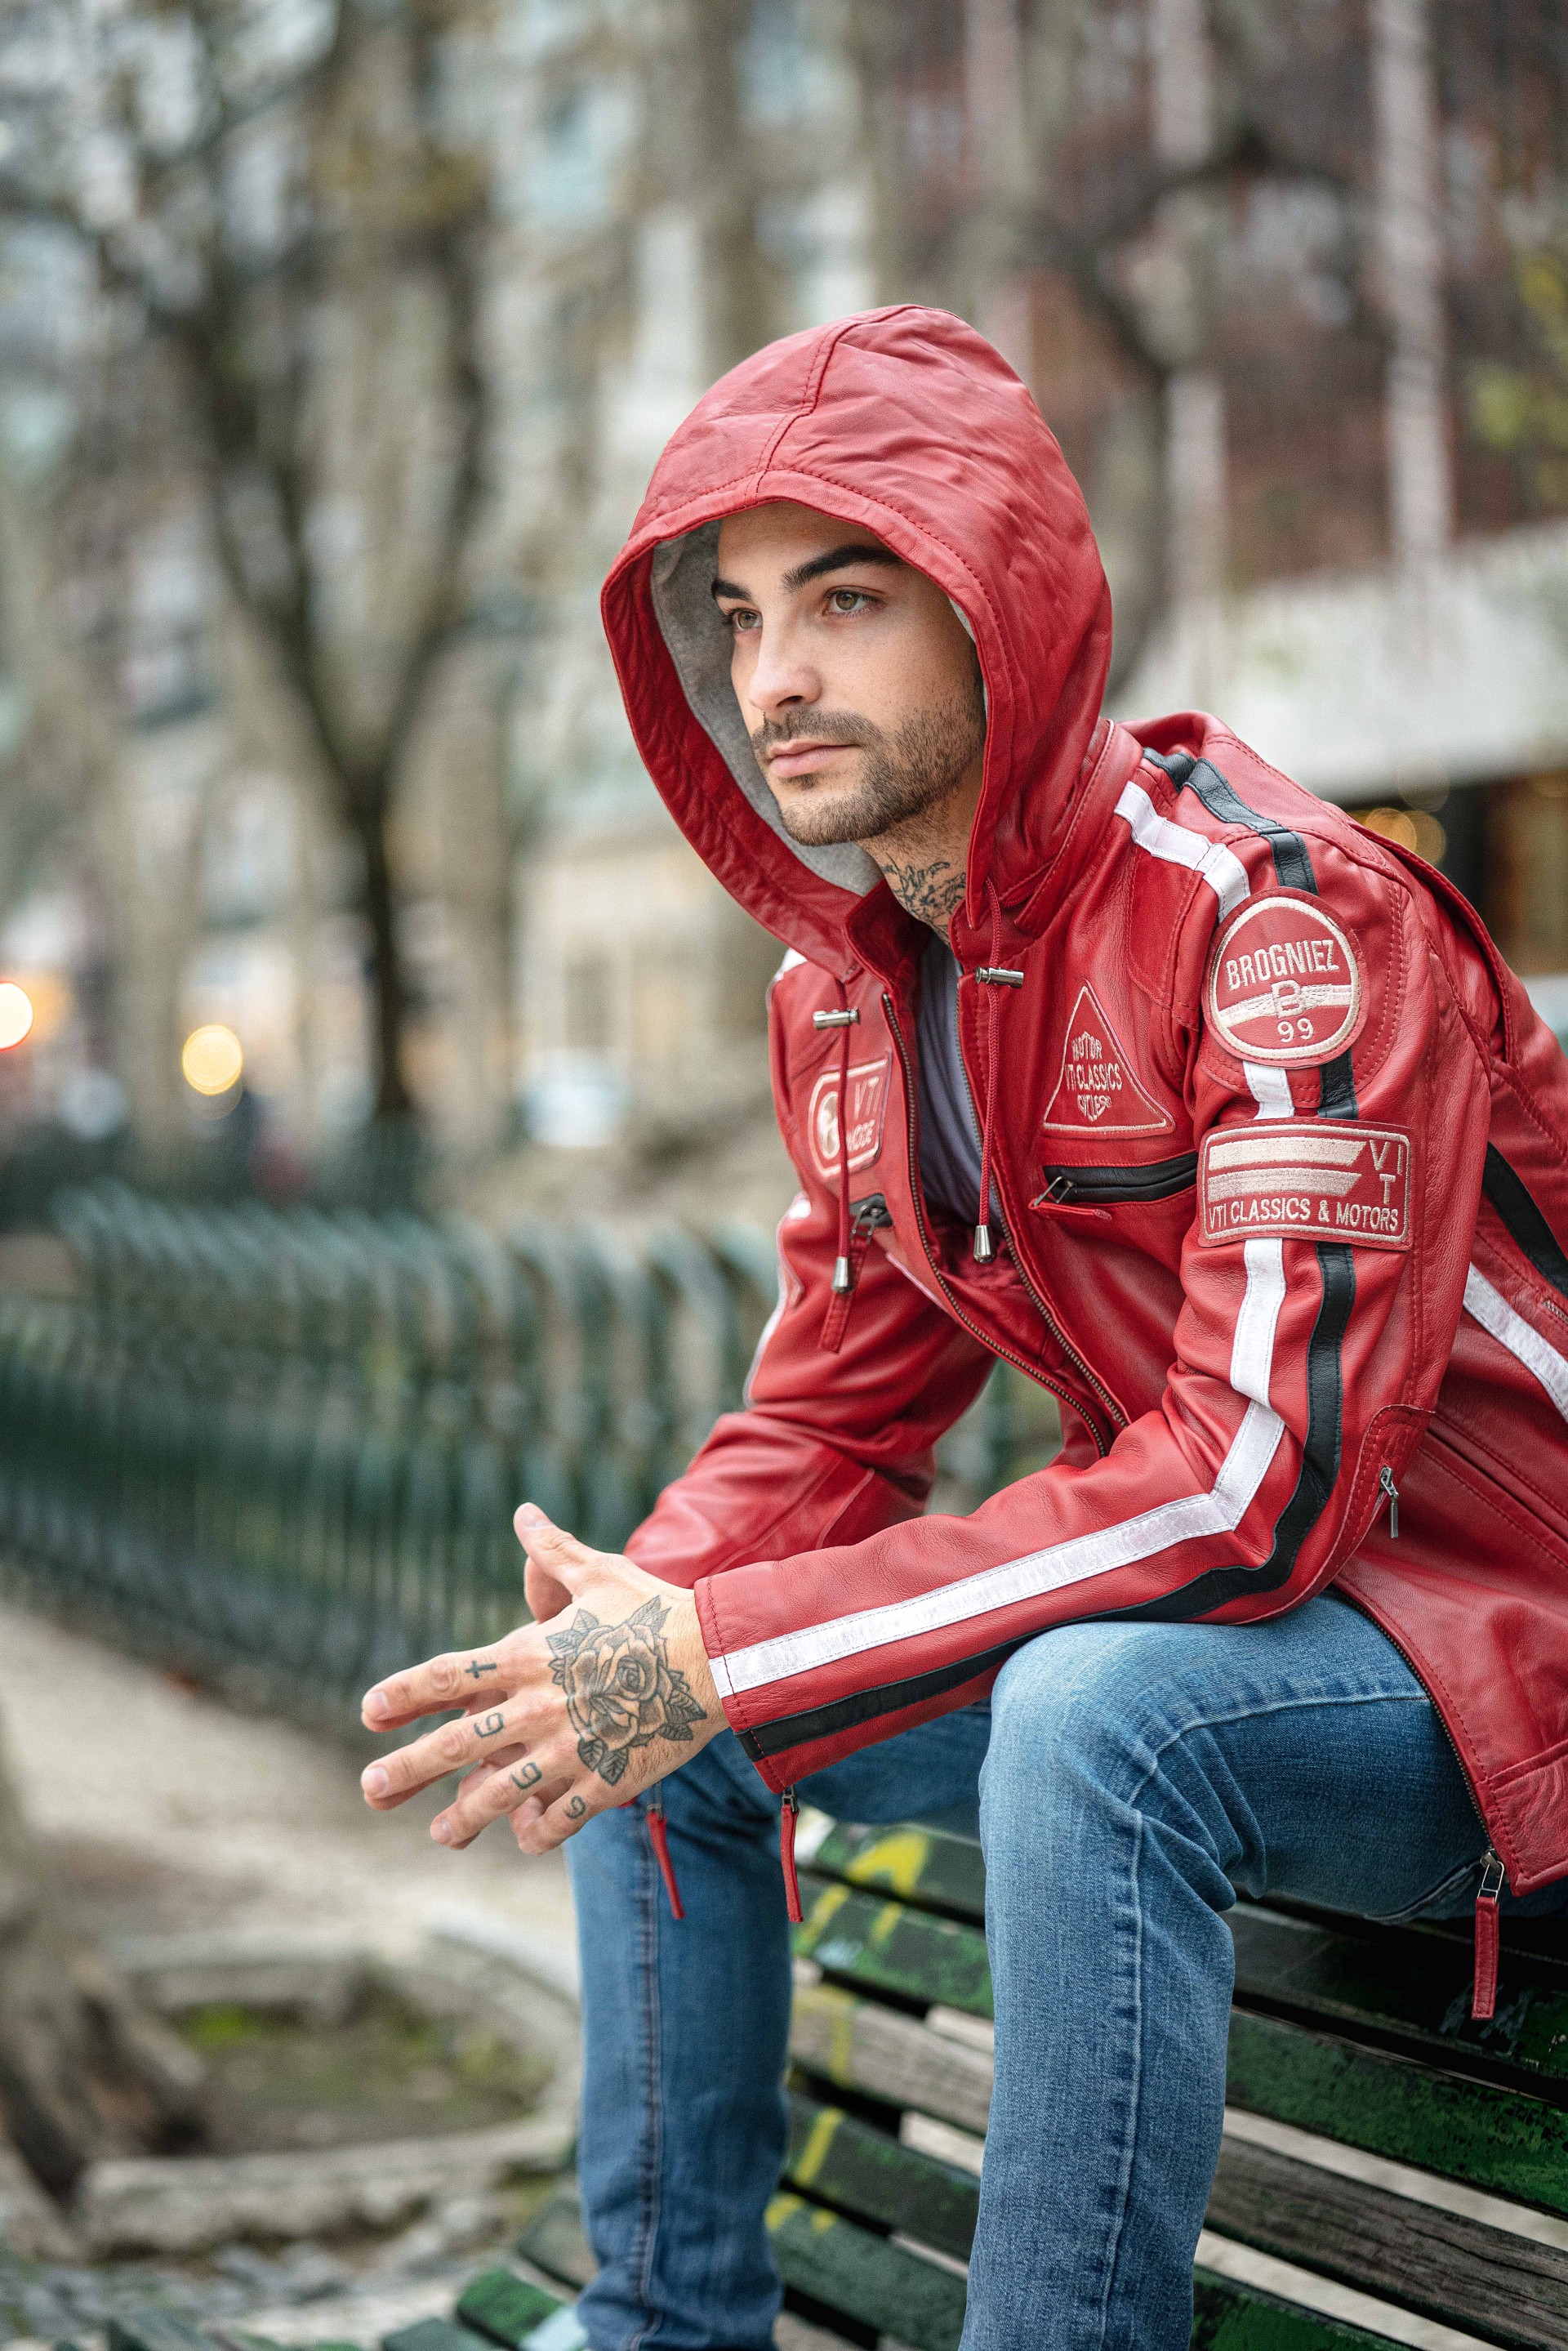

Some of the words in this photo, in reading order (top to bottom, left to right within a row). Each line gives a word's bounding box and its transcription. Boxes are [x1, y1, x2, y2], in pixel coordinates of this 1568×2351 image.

[1226, 939, 1339, 990] BROGNIEZ
[1272, 980, 1306, 1018] B
[1072, 1031, 1102, 1060] MOTOR
[1277, 1018, 1314, 1043] 99
[1076, 1063, 1122, 1091] CLASSICS
[1209, 1202, 1227, 1230] VTI
[1230, 1196, 1312, 1225] CLASSICS
[1317, 1198, 1331, 1224] &
[1335, 1201, 1400, 1233] MOTORS
